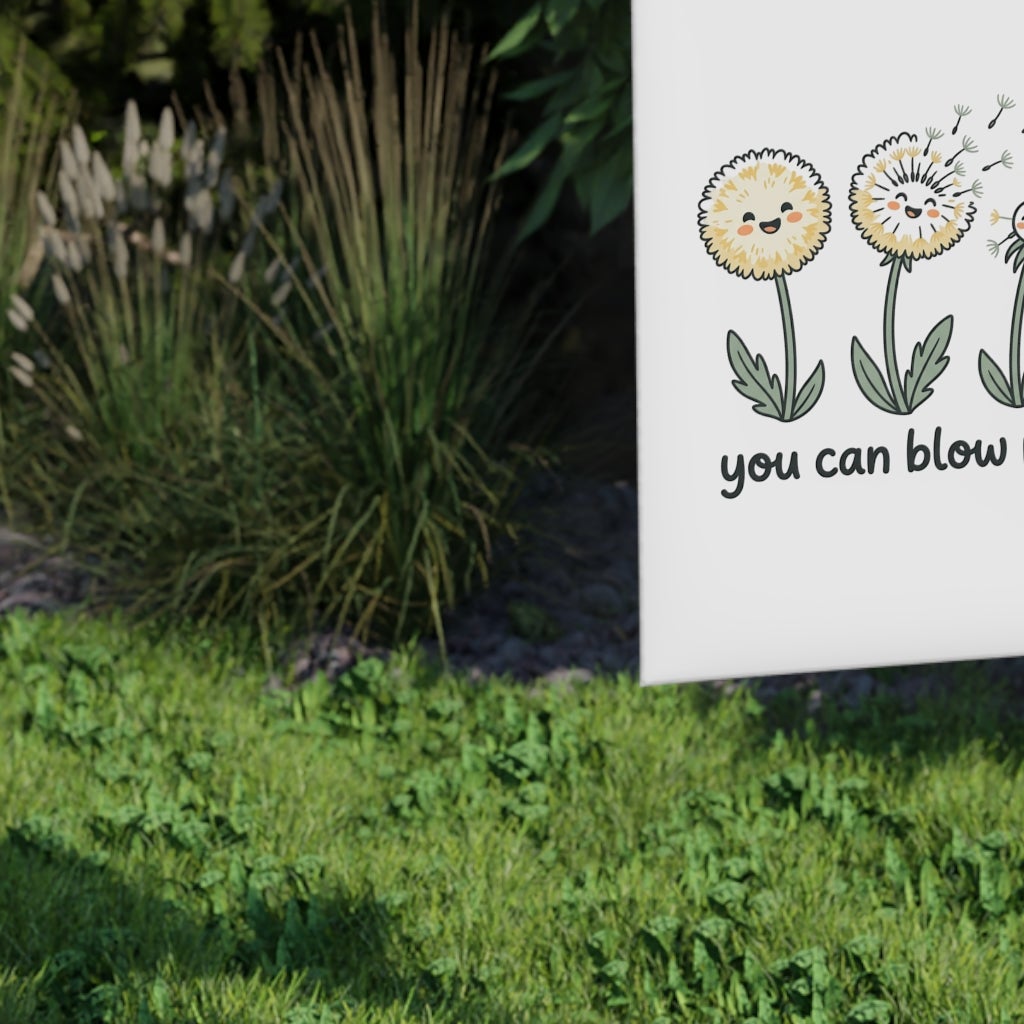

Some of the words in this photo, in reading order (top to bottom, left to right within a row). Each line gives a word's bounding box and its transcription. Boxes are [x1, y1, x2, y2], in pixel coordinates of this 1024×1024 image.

[720, 451, 801, 500] you
[815, 445, 891, 479] can
[906, 425, 1008, 473] blow
